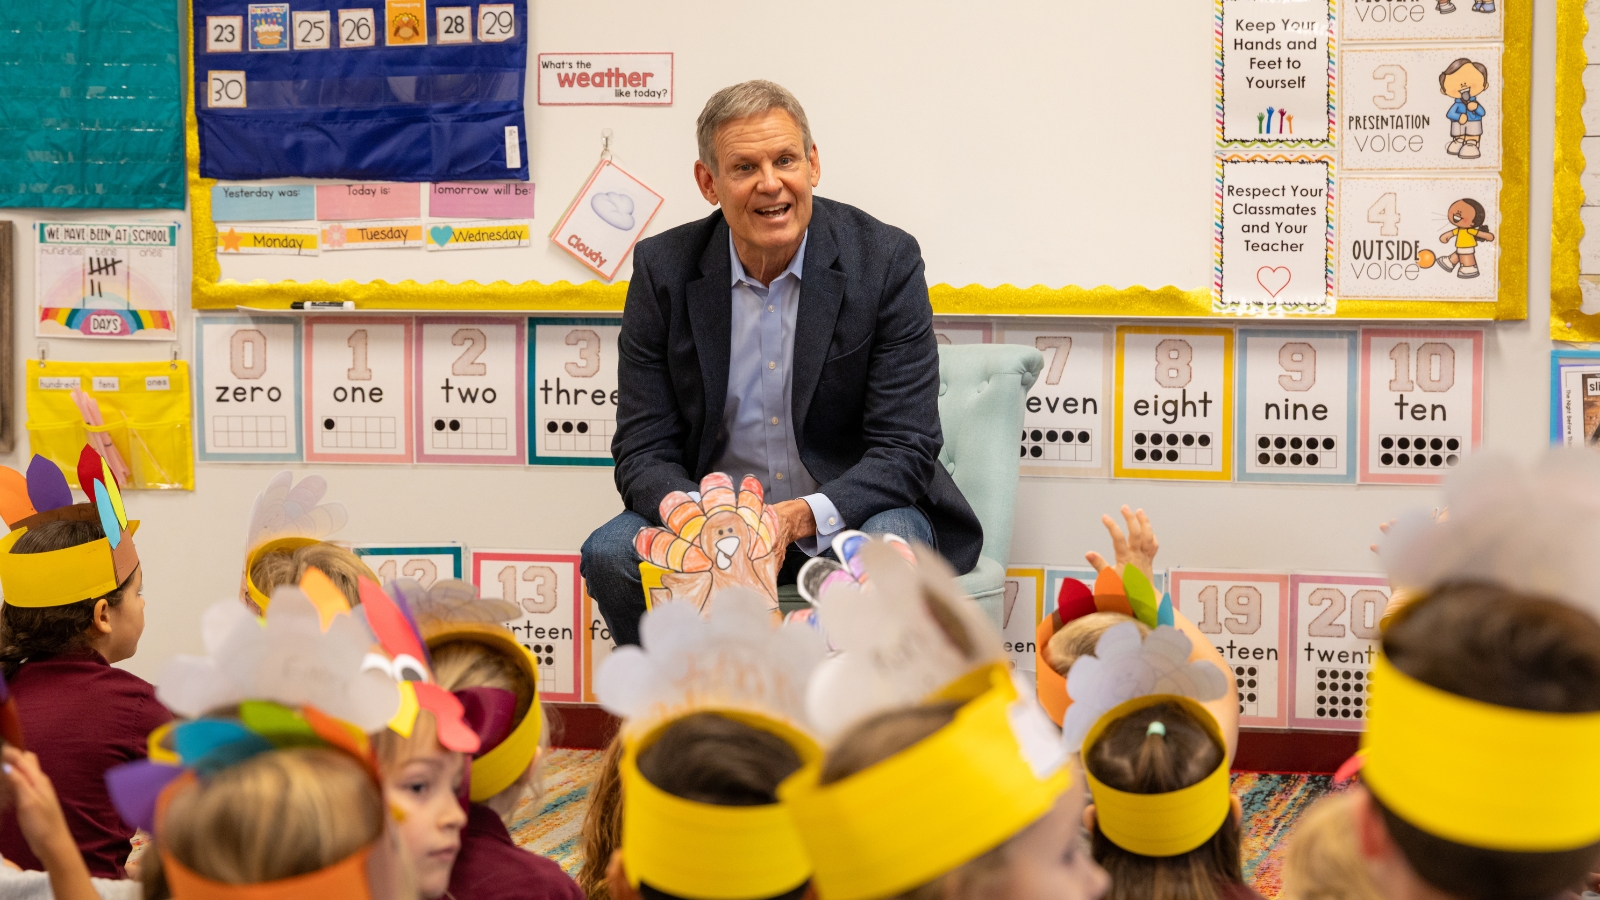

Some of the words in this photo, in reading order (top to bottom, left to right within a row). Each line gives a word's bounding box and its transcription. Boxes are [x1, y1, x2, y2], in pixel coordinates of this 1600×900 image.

[1355, 3, 1425, 22] voice
[298, 20, 325, 43] 25
[342, 17, 371, 42] 26
[443, 15, 465, 35] 28
[482, 11, 513, 35] 29
[1235, 19, 1276, 34] Keep
[1281, 18, 1316, 31] Your
[213, 24, 235, 43] 23
[1234, 38, 1282, 50] Hands
[1287, 37, 1317, 50] and
[541, 60, 573, 69] What's
[576, 60, 592, 69] the
[1250, 57, 1282, 70] Feet
[1286, 56, 1302, 70] to
[557, 67, 654, 88] weather
[1246, 76, 1306, 89] Yourself
[1373, 64, 1408, 110] 3
[212, 78, 243, 102] 30
[615, 89, 631, 98] like
[633, 89, 668, 99] today?
[1348, 114, 1431, 130] PRESENTATION
[1354, 133, 1424, 152] voice
[223, 187, 274, 199] Yesterday
[278, 189, 301, 198] was:
[346, 184, 376, 198] Today
[380, 186, 391, 195] is:
[431, 182, 489, 195] Tomorrow
[494, 184, 511, 195] will
[515, 184, 532, 196] be:
[1227, 185, 1286, 199] Respect
[1291, 185, 1324, 198] Your
[1233, 203, 1317, 216] Classmates
[1367, 192, 1401, 236] 4
[46, 228, 60, 240] WE
[64, 228, 85, 241] HAVE
[90, 229, 111, 241] BEEN
[115, 229, 128, 241] AT
[132, 229, 169, 243] SCHOOL
[358, 227, 409, 245] Tuesday
[452, 229, 523, 246] Wednesday
[1241, 221, 1270, 234] and
[1275, 221, 1308, 234] Your
[254, 235, 304, 256] Monday
[567, 234, 607, 268] Cloudy
[1244, 240, 1305, 252] Teacher
[1352, 240, 1420, 261] OUTSIDE
[1351, 261, 1420, 281] voice
[92, 318, 119, 331] DAYS
[230, 329, 267, 380] 0
[347, 329, 372, 381] 1
[451, 328, 487, 377] 2
[565, 329, 601, 378] 3
[1035, 336, 1073, 385] 7
[1155, 339, 1193, 389] 8
[1278, 342, 1317, 392] 9
[1389, 342, 1456, 393] 10
[215, 386, 282, 403] zero
[333, 386, 384, 403] one
[441, 378, 497, 404] two
[1026, 396, 1098, 415] even
[1133, 388, 1213, 424] eight
[1265, 398, 1329, 421] nine
[1394, 394, 1447, 421] ten
[498, 565, 558, 614] 13
[1198, 585, 1262, 635] 19
[1308, 587, 1388, 640] 20
[1304, 642, 1376, 665] twent
